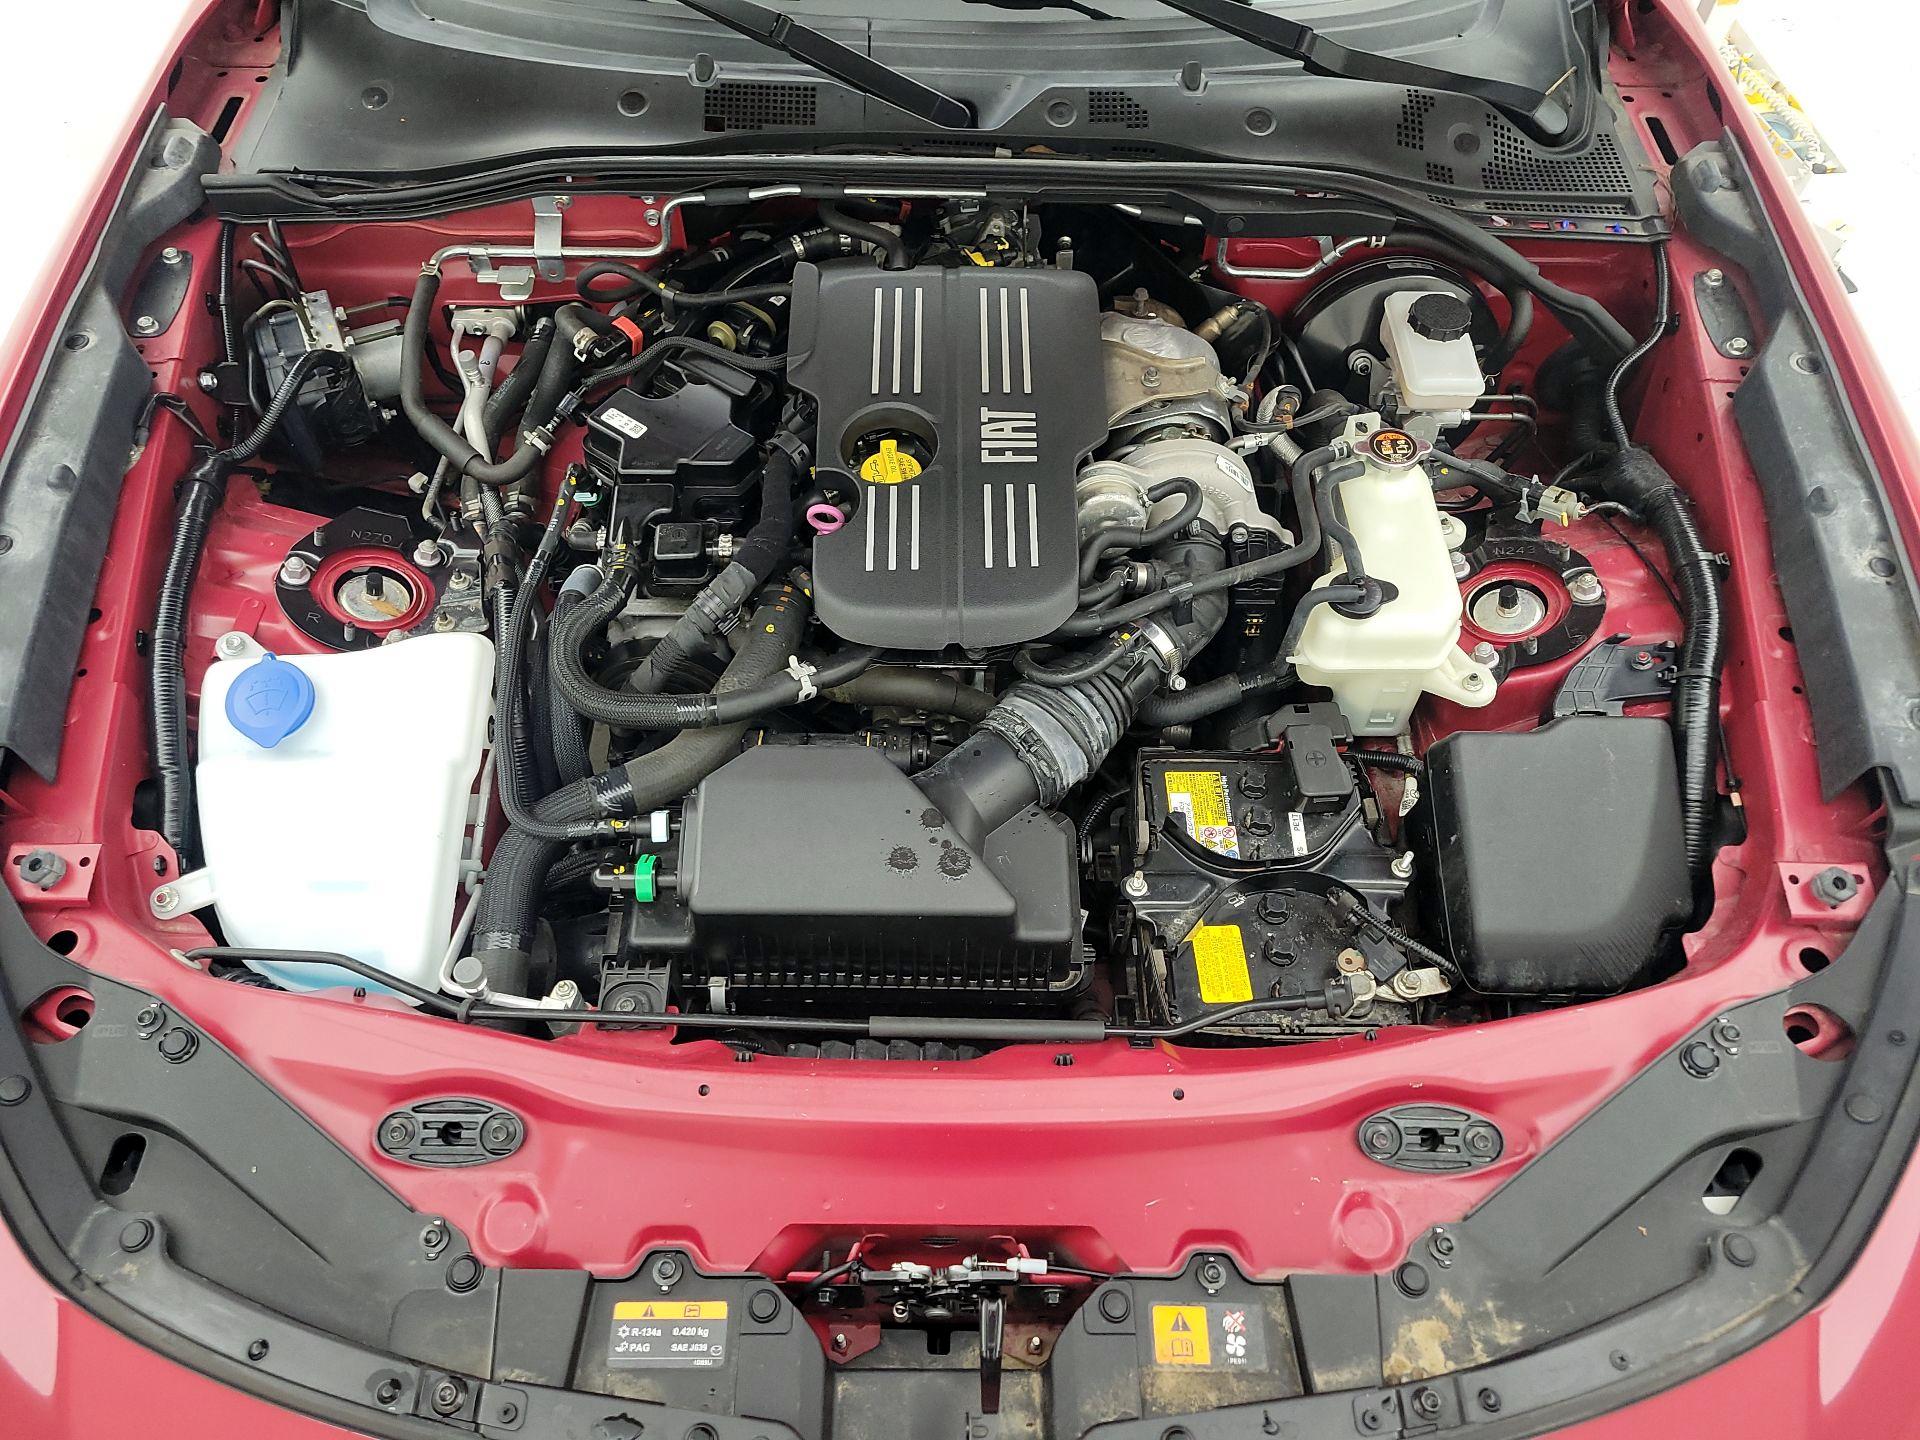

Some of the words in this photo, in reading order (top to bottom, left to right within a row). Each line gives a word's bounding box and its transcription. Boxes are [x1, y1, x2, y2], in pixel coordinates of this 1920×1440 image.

[980, 407, 1038, 463] FIAT
[1254, 434, 1263, 446] 52
[886, 447, 895, 465] ENGINE
[350, 530, 392, 543] N270
[1495, 546, 1537, 555] N243
[305, 612, 321, 624] R
[1222, 788, 1233, 823] Performance
[631, 1327, 662, 1337] R-134a
[672, 1327, 696, 1336] 0.420
[697, 1327, 709, 1338] kg
[628, 1343, 651, 1352] PAG
[670, 1343, 688, 1352] SAE
[689, 1343, 708, 1352] J639
